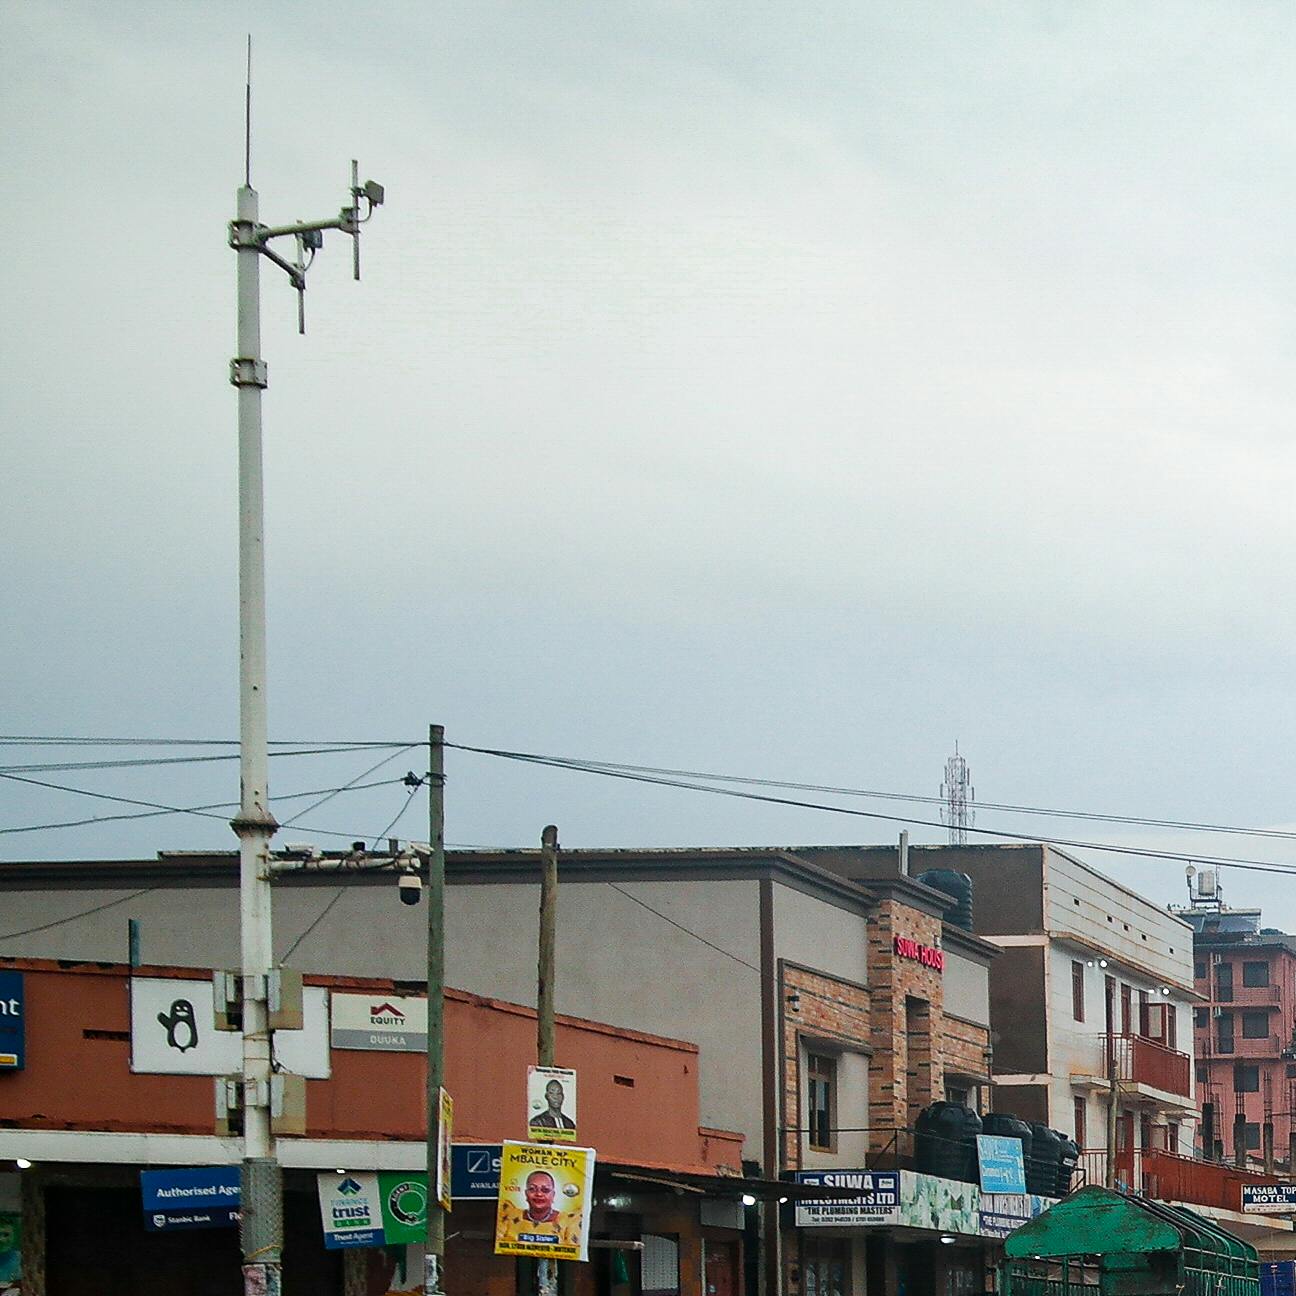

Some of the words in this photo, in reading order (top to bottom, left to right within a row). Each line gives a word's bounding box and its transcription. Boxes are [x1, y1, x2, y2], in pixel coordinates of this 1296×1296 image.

[897, 935, 920, 960] SUWA
[370, 1016, 405, 1025] EQUITY
[510, 1154, 547, 1165] MBALE
[551, 1157, 577, 1168] CITY
[157, 1185, 216, 1198] Authorised
[1244, 1186, 1278, 1195] MASABA
[876, 1192, 895, 1204] LTD
[1253, 1194, 1289, 1203] MOTEL
[332, 1206, 370, 1218] trust
